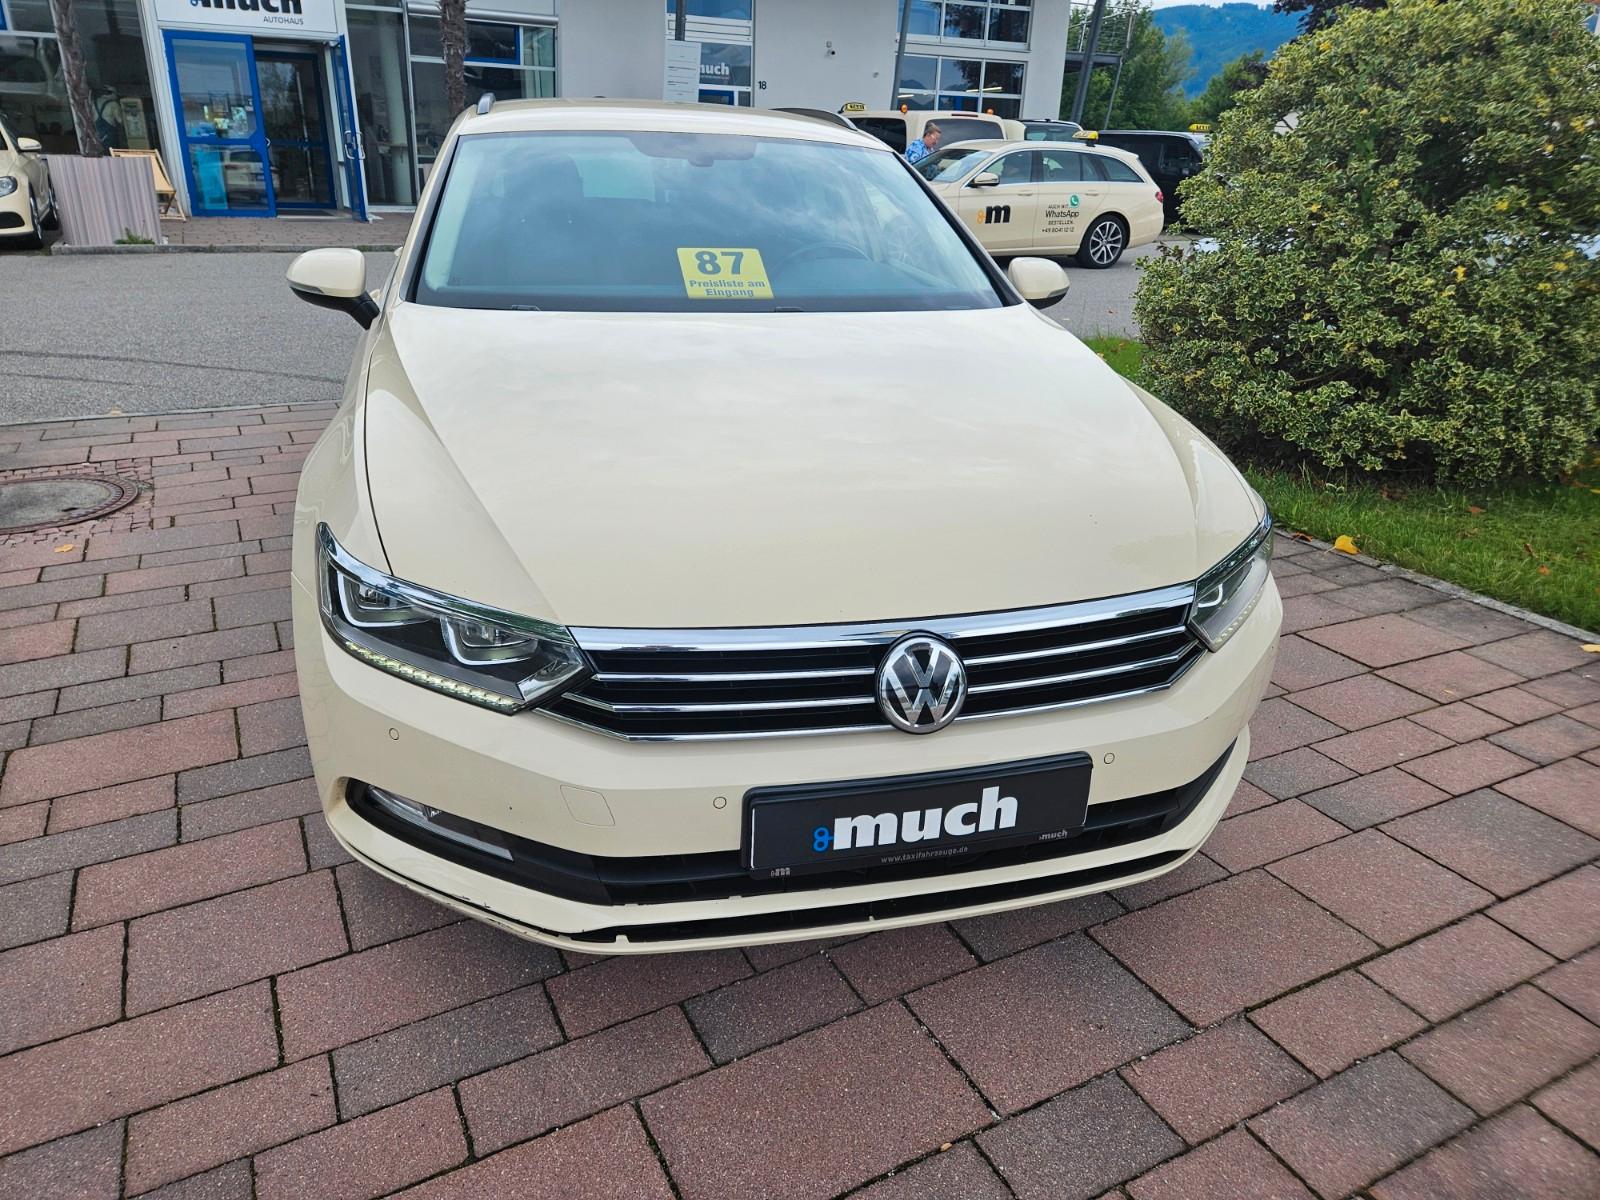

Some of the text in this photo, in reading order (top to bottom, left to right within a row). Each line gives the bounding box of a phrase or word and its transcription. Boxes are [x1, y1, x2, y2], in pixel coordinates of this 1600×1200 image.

[263, 15, 304, 25] AUTOHAUS
[758, 80, 767, 90] 18
[1045, 210, 1080, 219] WhatsApp
[694, 250, 744, 275] 87
[689, 280, 766, 288] Preisliste am
[705, 288, 755, 298] Eingang
[833, 785, 1019, 850] much
[880, 846, 969, 863] www.taxifahrzeuge.de
